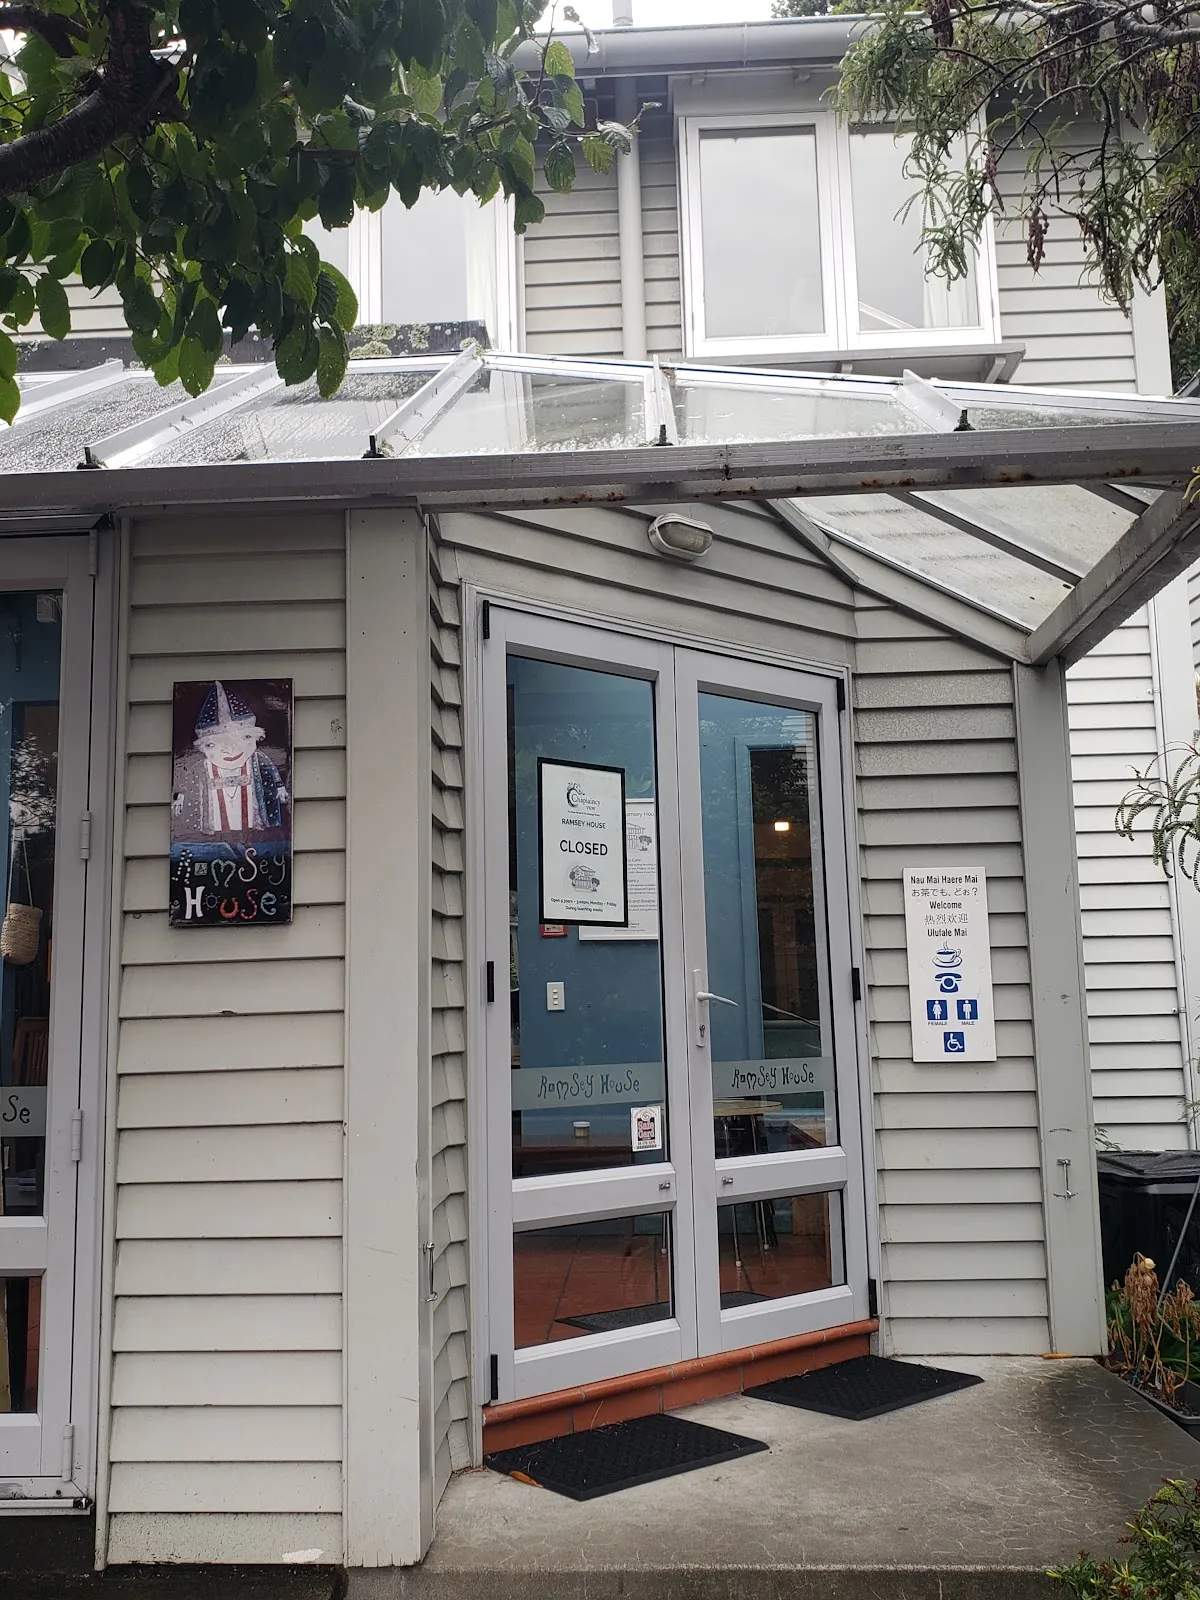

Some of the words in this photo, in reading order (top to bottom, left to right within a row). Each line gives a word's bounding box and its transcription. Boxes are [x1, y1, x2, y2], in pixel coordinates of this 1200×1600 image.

[561, 818, 585, 827] RAMSEY
[586, 820, 607, 830] HOUSE
[559, 839, 608, 856] CLOSED
[910, 875, 925, 884] Nau
[926, 875, 940, 884] Mai
[941, 875, 963, 884] Haere
[964, 874, 978, 884] Mai
[929, 900, 963, 910] Welcome
[954, 927, 968, 937] Mai
